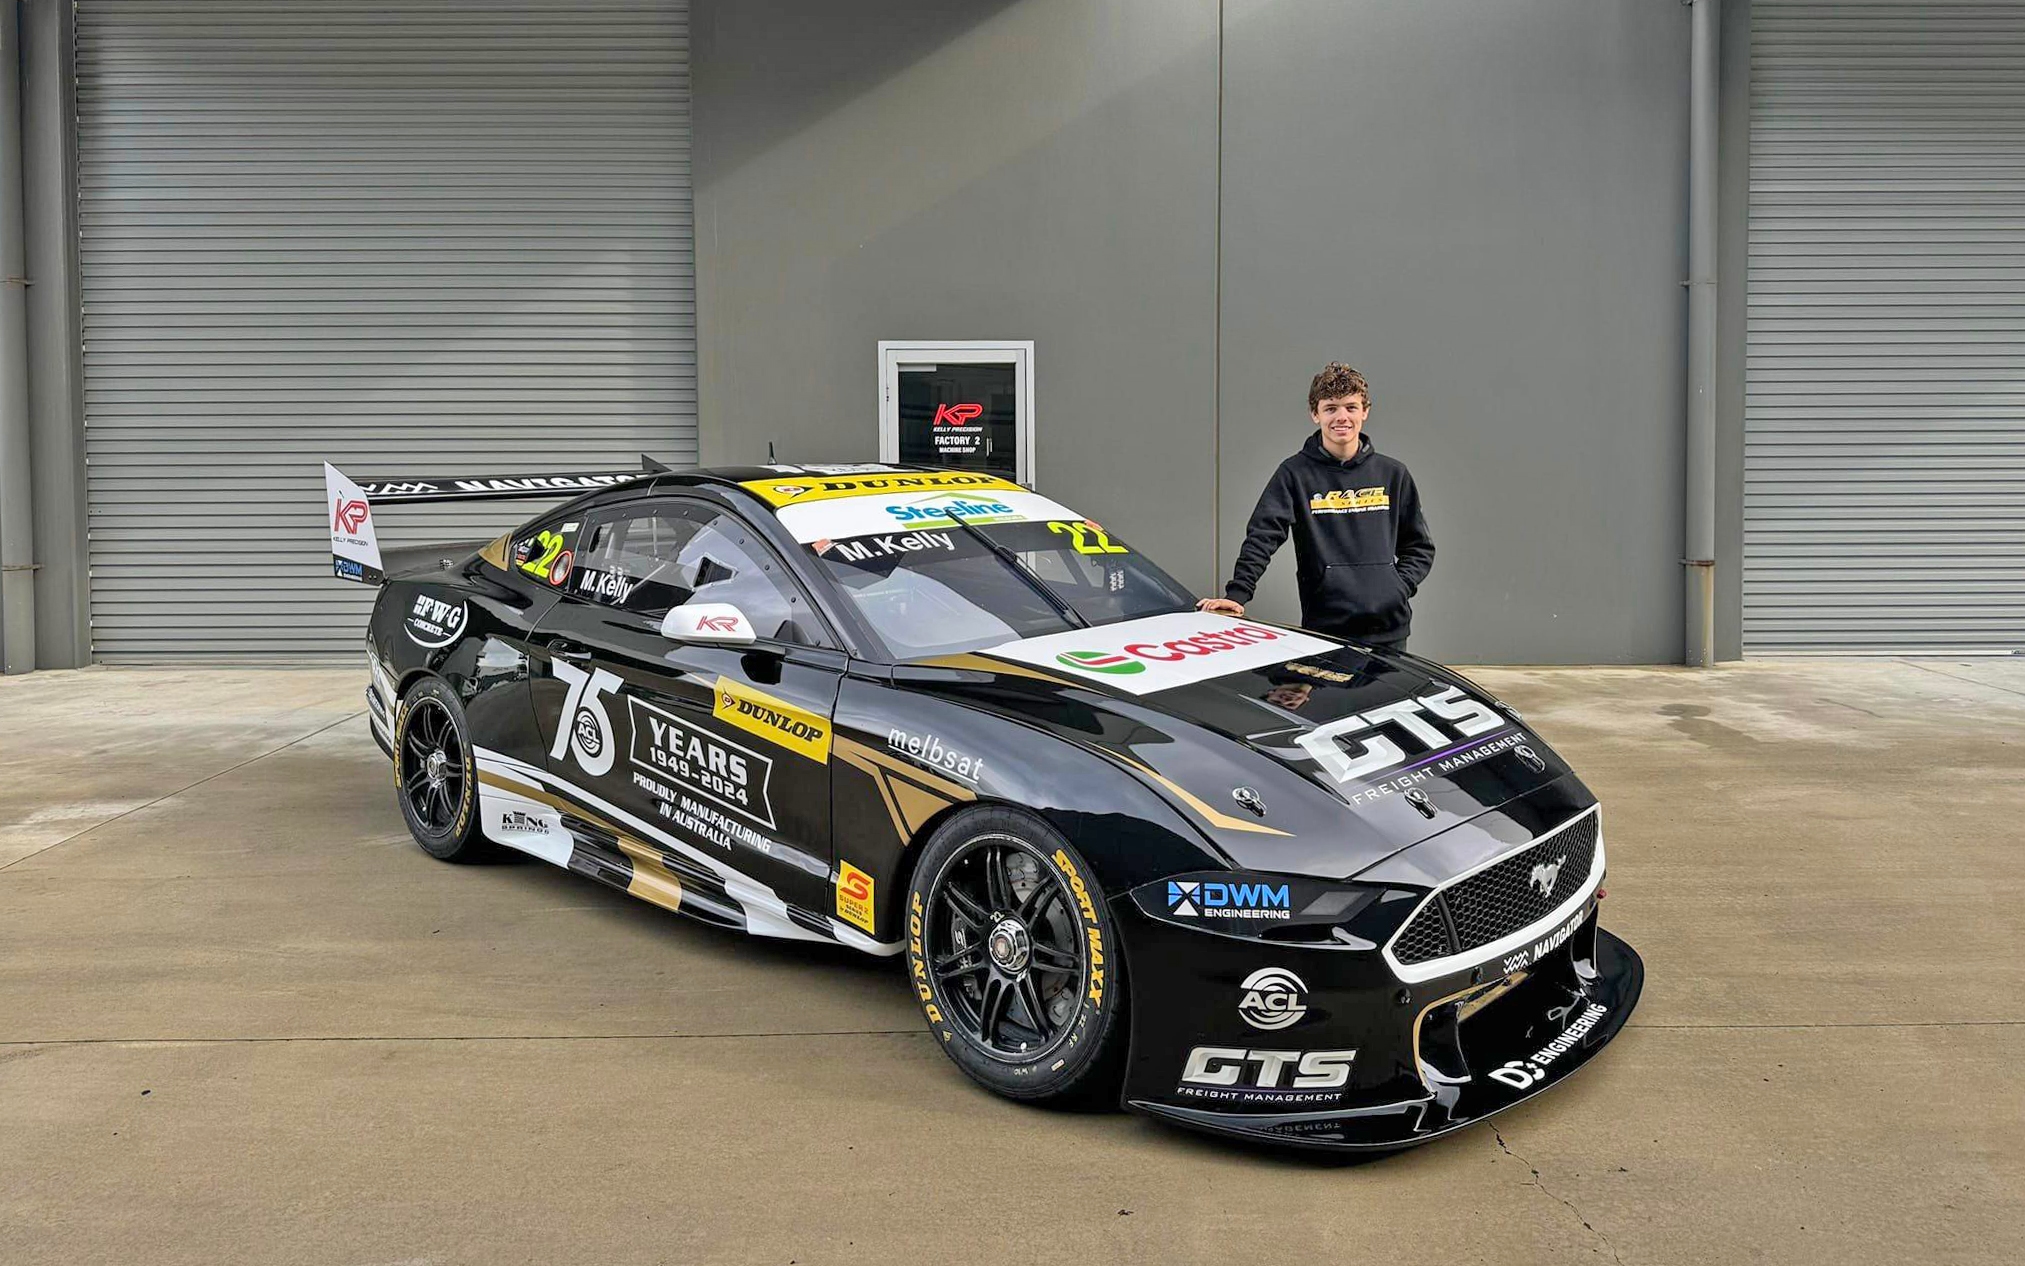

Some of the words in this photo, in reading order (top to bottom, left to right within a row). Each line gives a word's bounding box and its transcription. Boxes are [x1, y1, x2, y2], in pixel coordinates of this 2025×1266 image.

[935, 436, 970, 445] FACTORY
[974, 436, 980, 445] 2
[886, 501, 1013, 521] Steeline
[522, 530, 563, 578] 22
[835, 531, 955, 561] M.Kelly
[1047, 521, 1129, 554] 22
[580, 570, 634, 604] M.Kelly
[1124, 623, 1287, 661] Castrol
[550, 656, 624, 776] 75
[577, 721, 600, 744] ACL
[737, 698, 824, 743] DUNLOP
[1294, 685, 1505, 783] GTS
[649, 716, 748, 786] YEARS
[888, 728, 984, 780] melbsat
[1352, 767, 1434, 805] FREIGHT
[1439, 732, 1526, 778] MANAGEMENT
[650, 747, 749, 806] 1949-2024
[633, 771, 677, 803] PROUDLY
[681, 797, 772, 852] MANUFACTURING
[659, 802, 672, 818] IN
[672, 808, 732, 851] AUSTRALIA
[990, 911, 1005, 923] 22
[1204, 883, 1290, 908] DWM
[1204, 909, 1290, 919] ENGINEERING
[1052, 849, 1098, 924] SPORT
[1087, 926, 1105, 1008] MAXX
[1533, 909, 1584, 962] NAVIGATOR
[910, 892, 943, 1024] DUNLOP
[1238, 991, 1307, 1011] ACL
[1530, 1003, 1607, 1065] ENGINEERING
[1181, 1047, 1357, 1088] GTS
[1177, 1087, 1239, 1100] FREIGHT
[1244, 1092, 1342, 1101] MANAGEMENT
